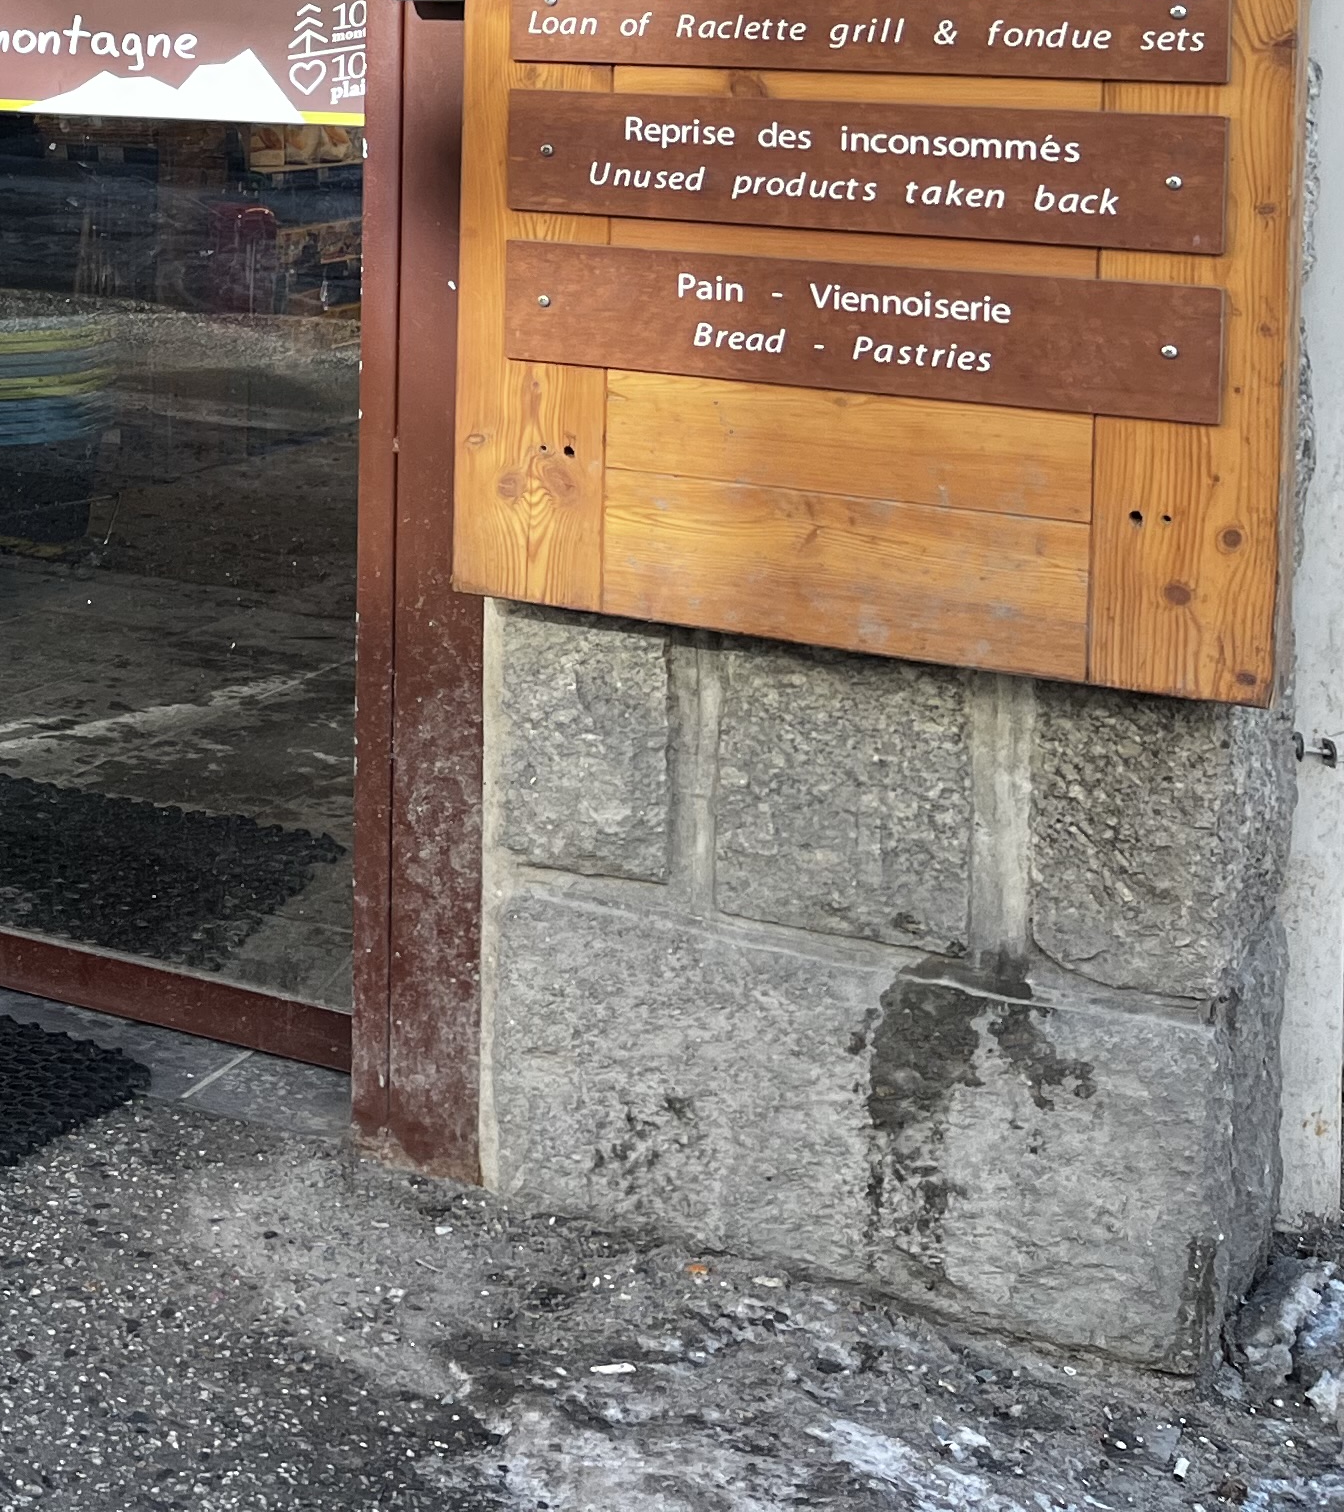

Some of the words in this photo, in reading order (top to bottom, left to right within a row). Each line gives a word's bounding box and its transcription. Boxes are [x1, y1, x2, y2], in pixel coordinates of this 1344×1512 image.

[528, 10, 598, 35] Loan
[619, 11, 653, 37] of
[675, 13, 807, 41] Raclette
[829, 17, 905, 49] grill
[933, 19, 958, 45] &
[987, 19, 1112, 49] fondue
[1139, 28, 1205, 52] sets
[625, 116, 735, 149] Reprise
[757, 121, 812, 150] des
[841, 125, 1080, 163] inconsommés
[589, 161, 706, 191] Unused
[731, 171, 877, 201] products
[905, 179, 1005, 209] taken
[1034, 184, 1119, 215] back
[677, 272, 744, 303] Pain
[809, 283, 1012, 324] Viennoiserie
[693, 322, 786, 353] Bread
[852, 335, 992, 372] Pastries
